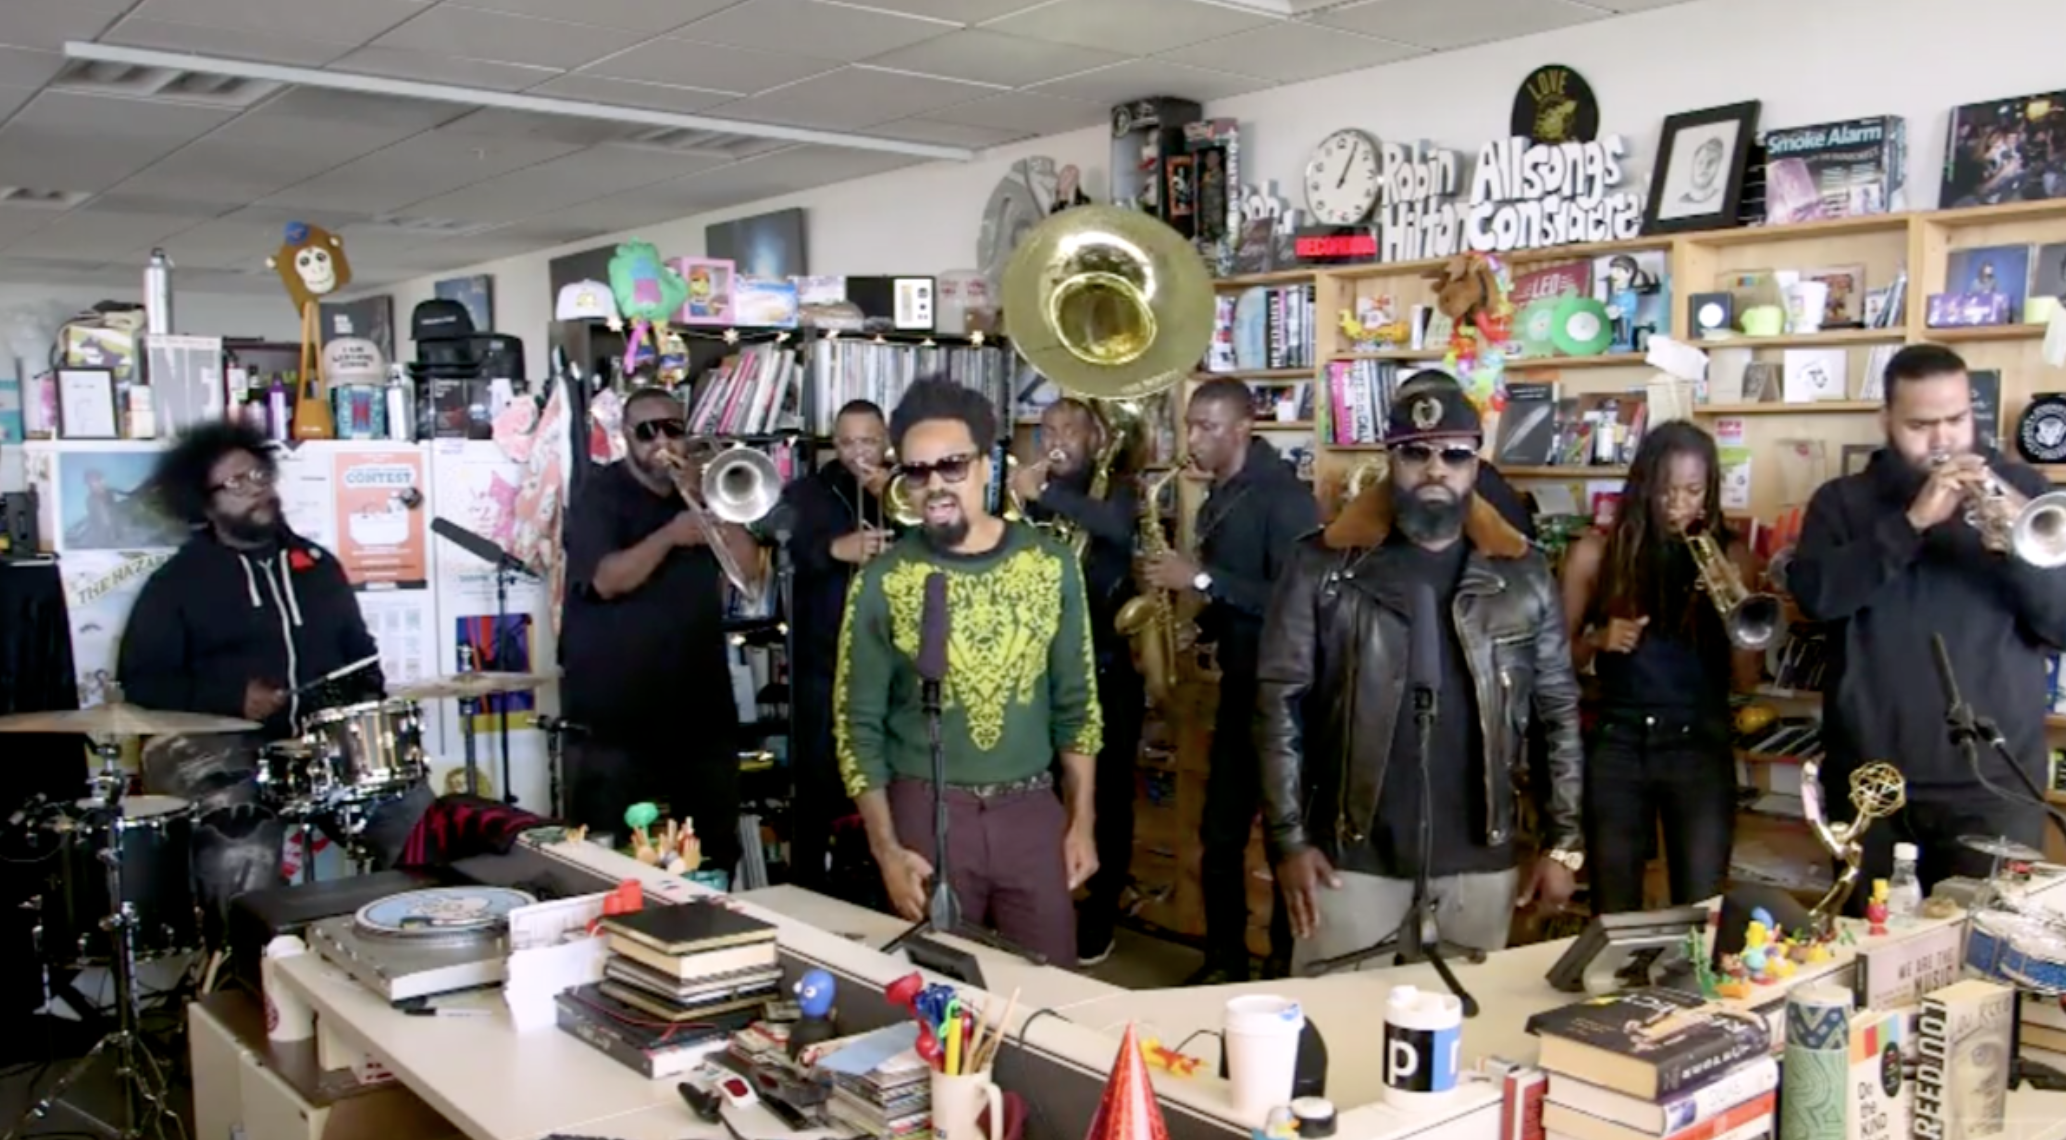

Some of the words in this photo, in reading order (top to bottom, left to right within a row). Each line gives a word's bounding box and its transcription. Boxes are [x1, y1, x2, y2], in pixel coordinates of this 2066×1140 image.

[1527, 69, 1570, 99] LOVE
[1767, 131, 1826, 154] Smoke
[1827, 126, 1882, 146] Alarm
[1382, 139, 1456, 203] Robin
[1470, 134, 1626, 206] Allsongs
[1382, 195, 1469, 262] Hilton
[1468, 192, 1651, 251] Considere
[346, 472, 411, 484] CONTEST
[77, 575, 111, 604] THE
[1860, 1101, 1877, 1119] the
[1914, 1064, 1943, 1140] REED
[1860, 1112, 1888, 1140] KIND
